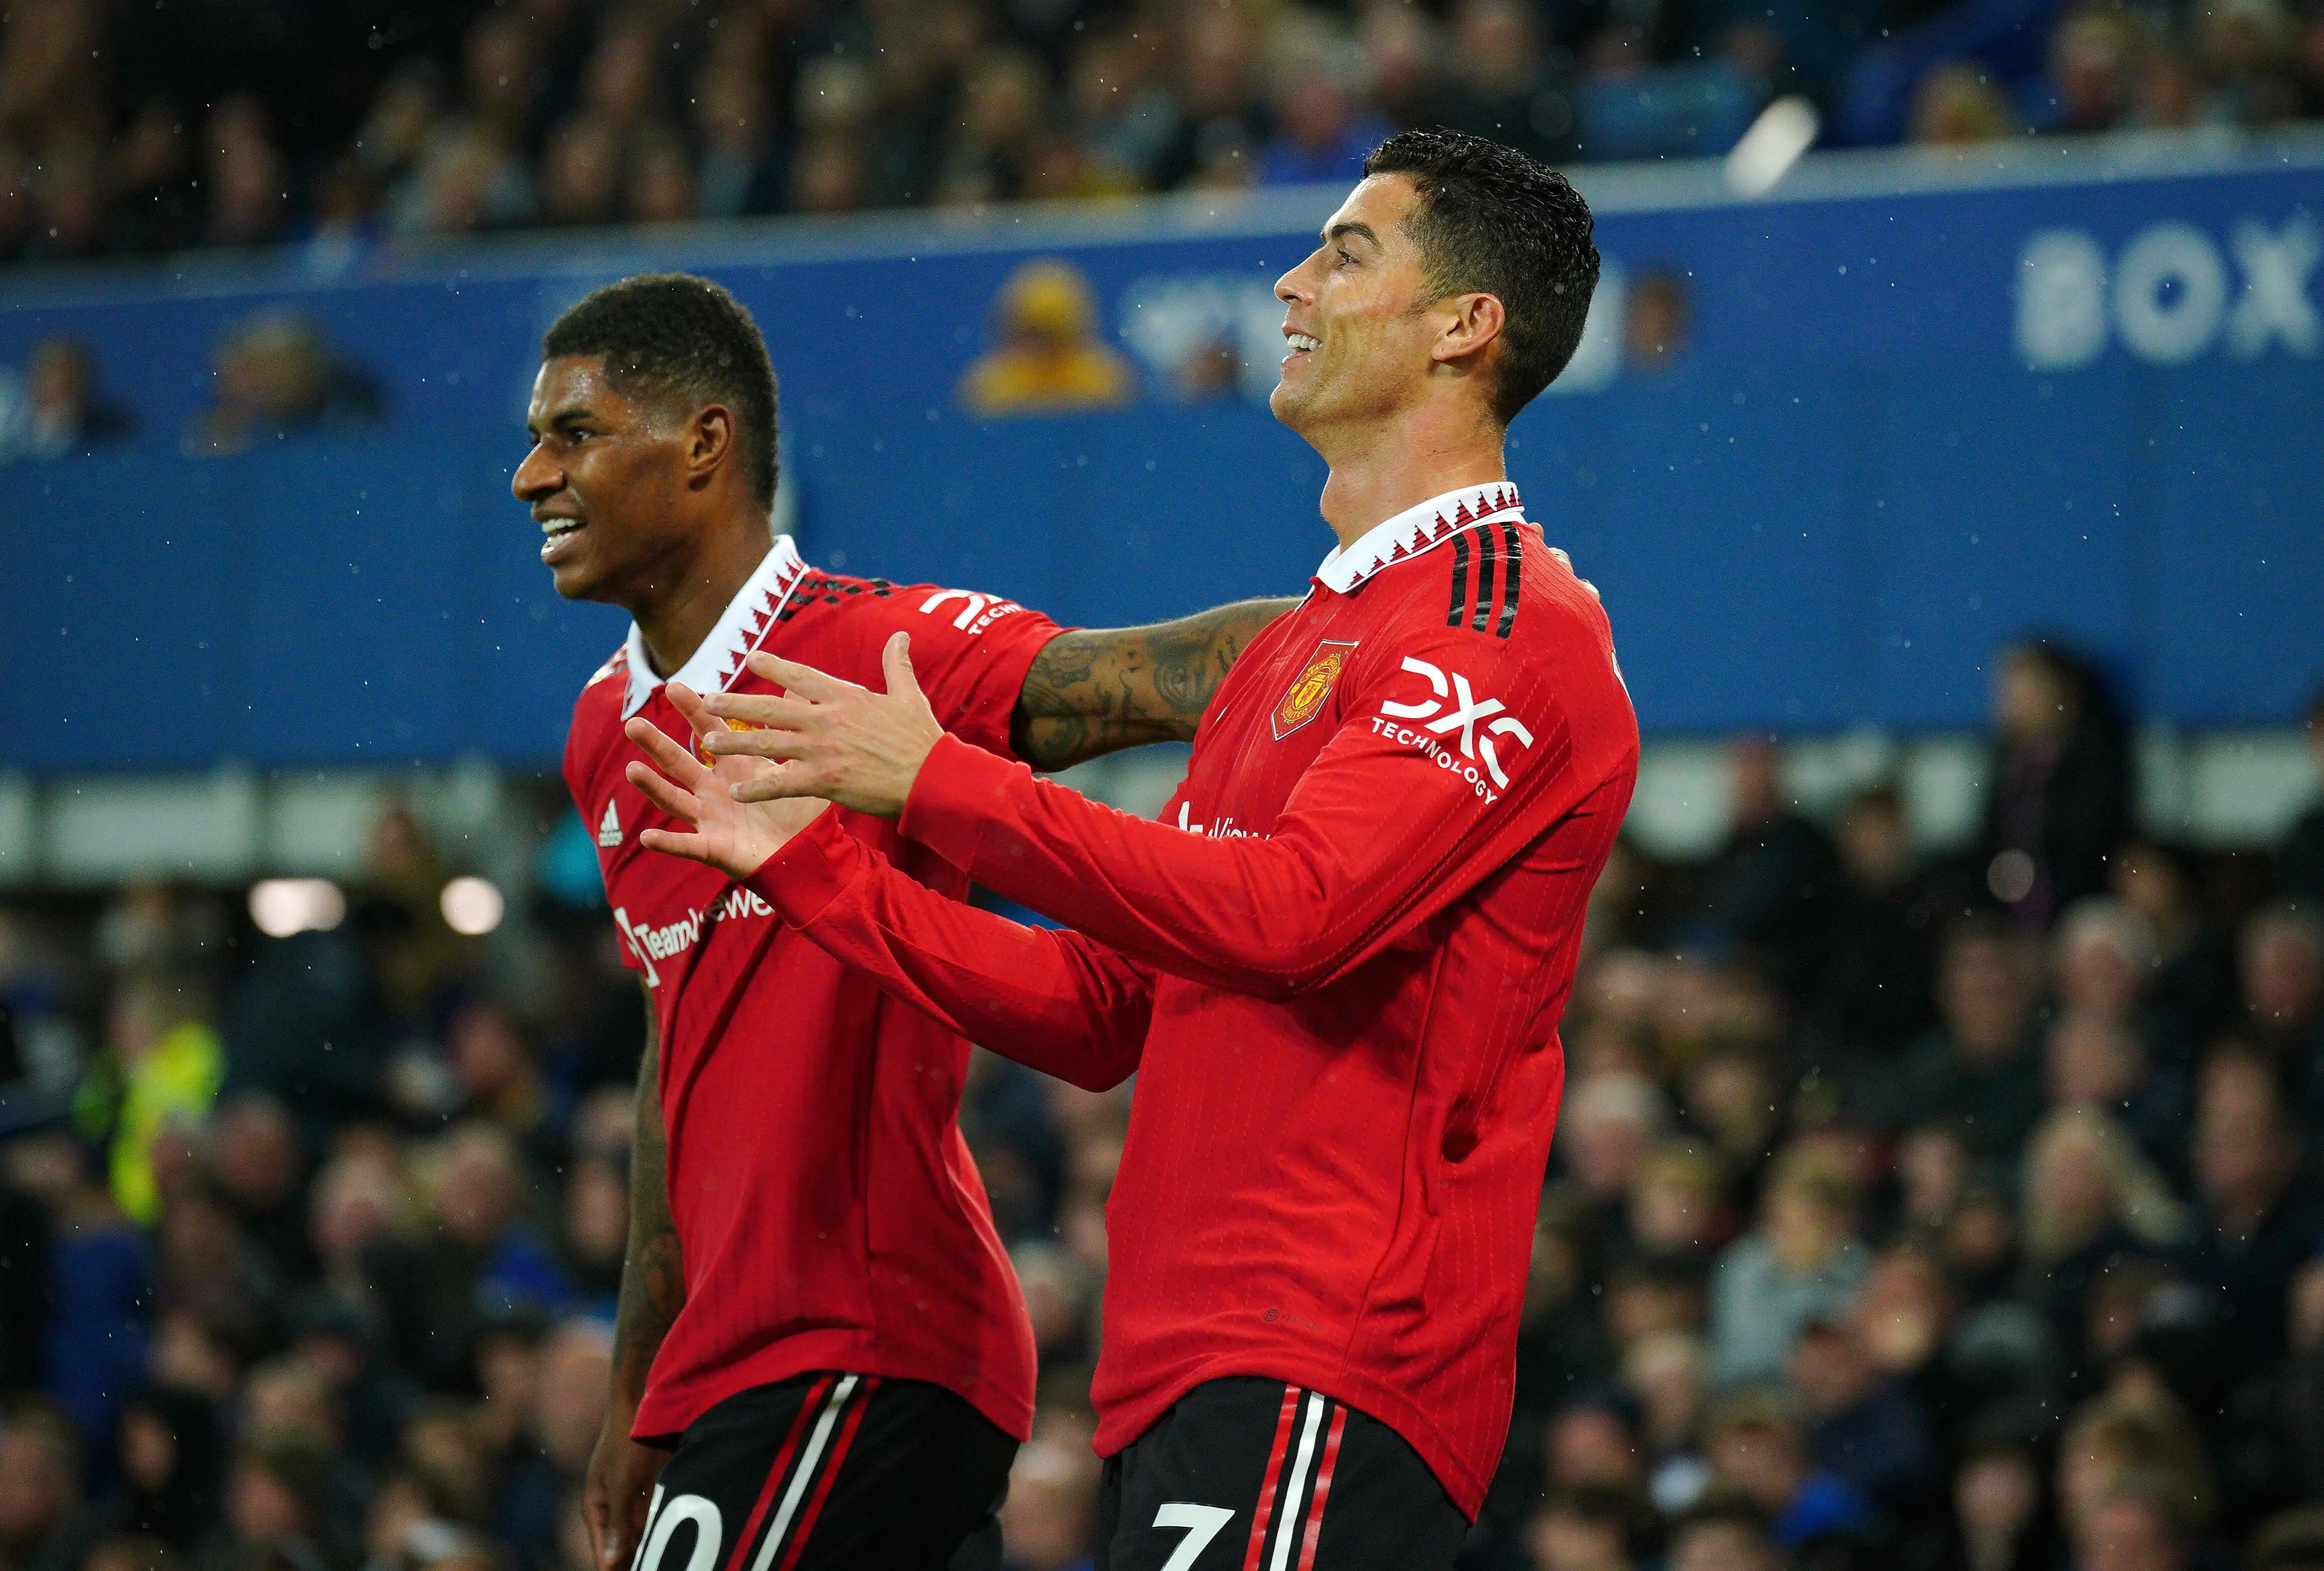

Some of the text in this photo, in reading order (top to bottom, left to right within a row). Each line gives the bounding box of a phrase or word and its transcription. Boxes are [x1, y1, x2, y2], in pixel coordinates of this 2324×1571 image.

[1285, 705, 1308, 719] UNITED
[1380, 656, 1534, 789] DXC
[1371, 717, 1498, 806] TECHNOLOGY
